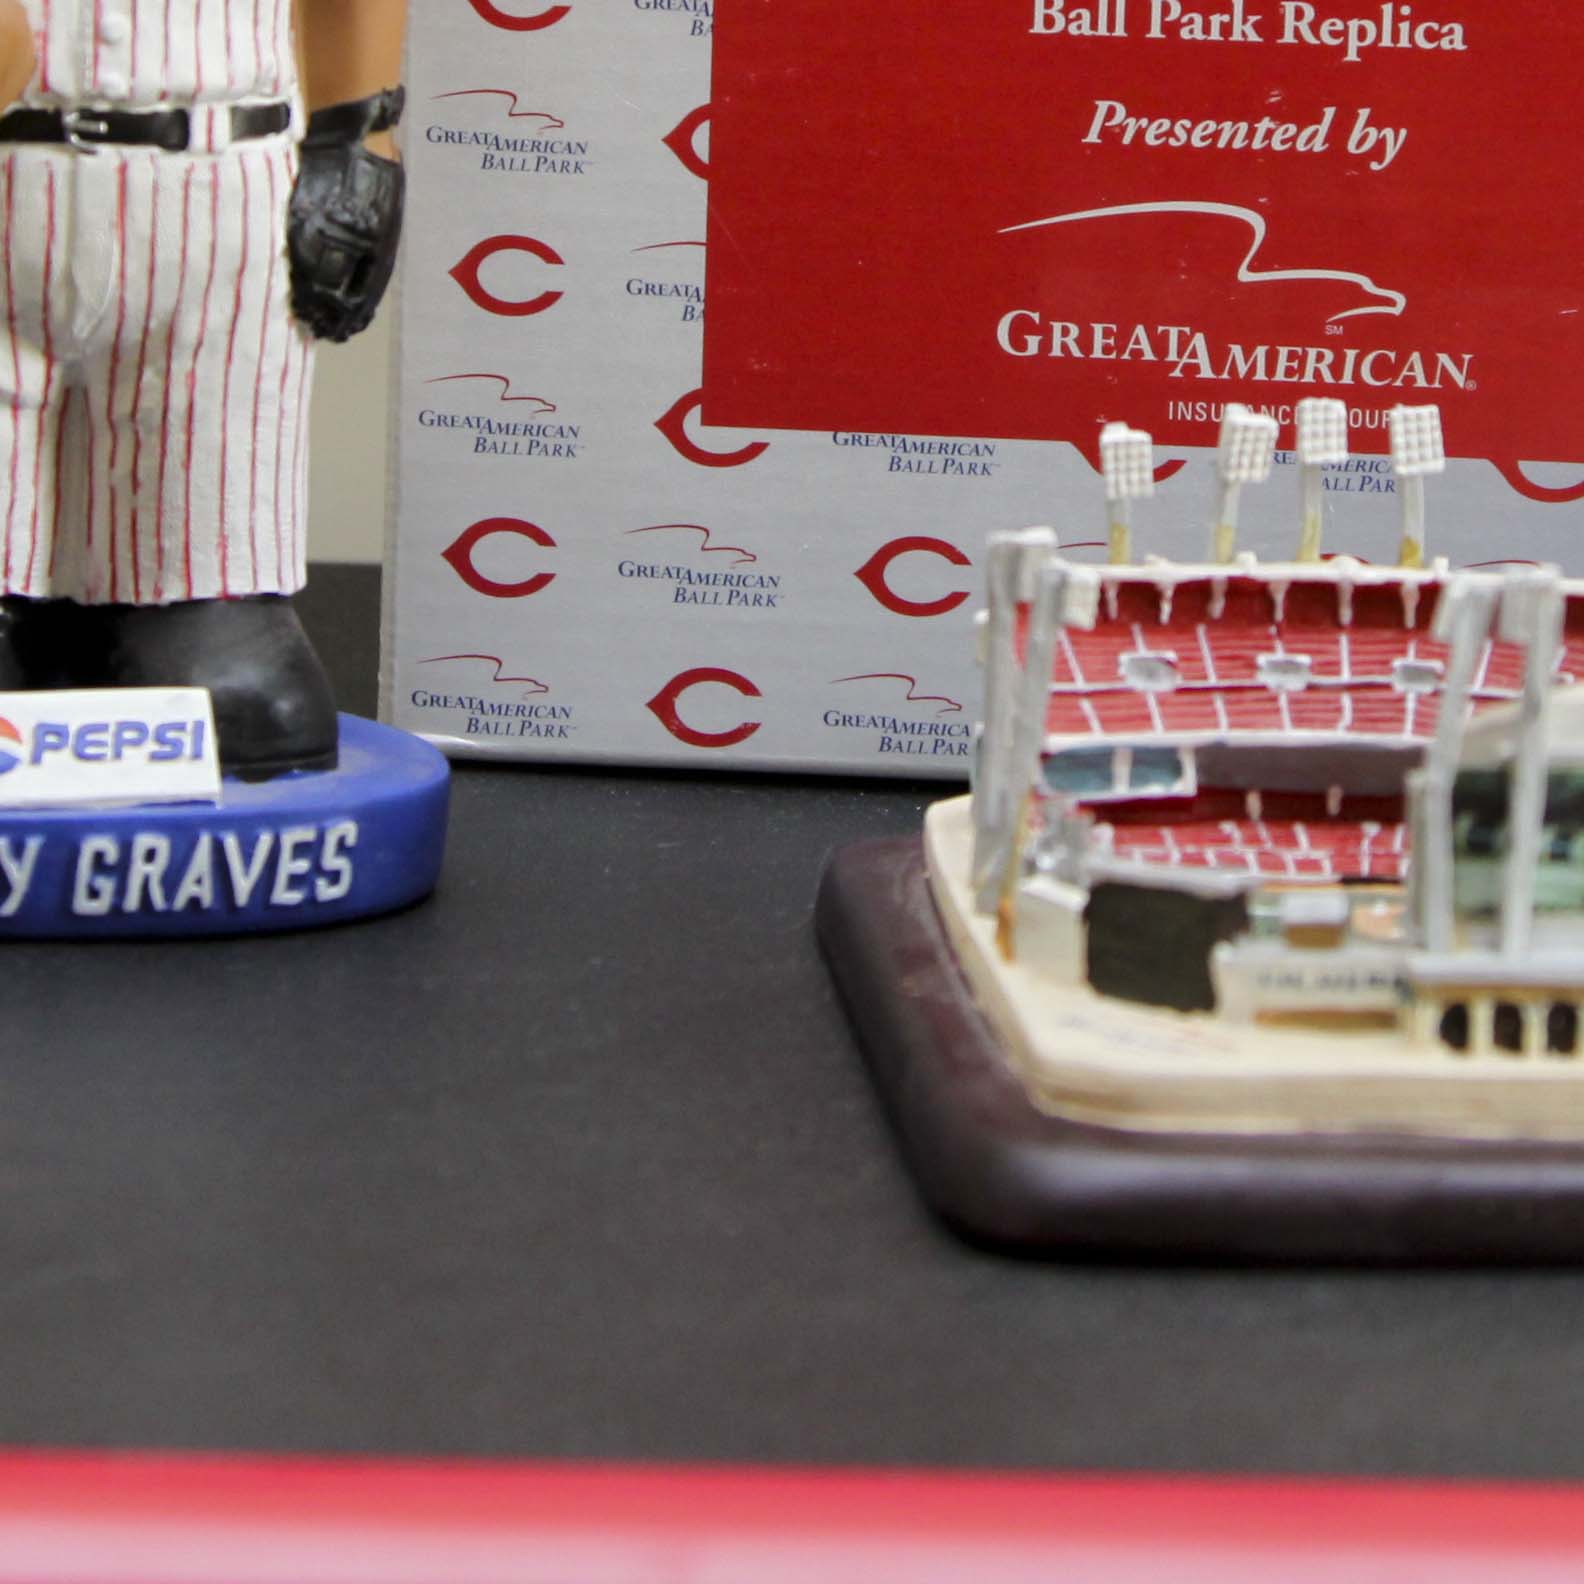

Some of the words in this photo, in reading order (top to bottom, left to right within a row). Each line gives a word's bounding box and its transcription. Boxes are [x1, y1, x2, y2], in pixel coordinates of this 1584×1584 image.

[1276, 0, 1468, 62] Replica
[1081, 100, 1337, 153] Presented
[1347, 107, 1408, 171] by
[480, 153, 530, 172] BALL
[533, 156, 585, 175] PARK
[473, 437, 523, 455] BALL
[526, 439, 577, 458] PARK
[887, 456, 938, 474] BALL
[941, 458, 992, 477] PARK
[1359, 474, 1396, 494] PAR
[672, 587, 722, 606] BALL
[725, 589, 777, 608] PARK
[465, 717, 515, 737] BALL
[517, 720, 569, 739] PARK
[822, 709, 969, 737] GREATAMERICA
[29, 718, 205, 766] PEPSI
[877, 736, 927, 755] BALL
[931, 737, 969, 757] PAR
[73, 819, 359, 917] GRAVES
